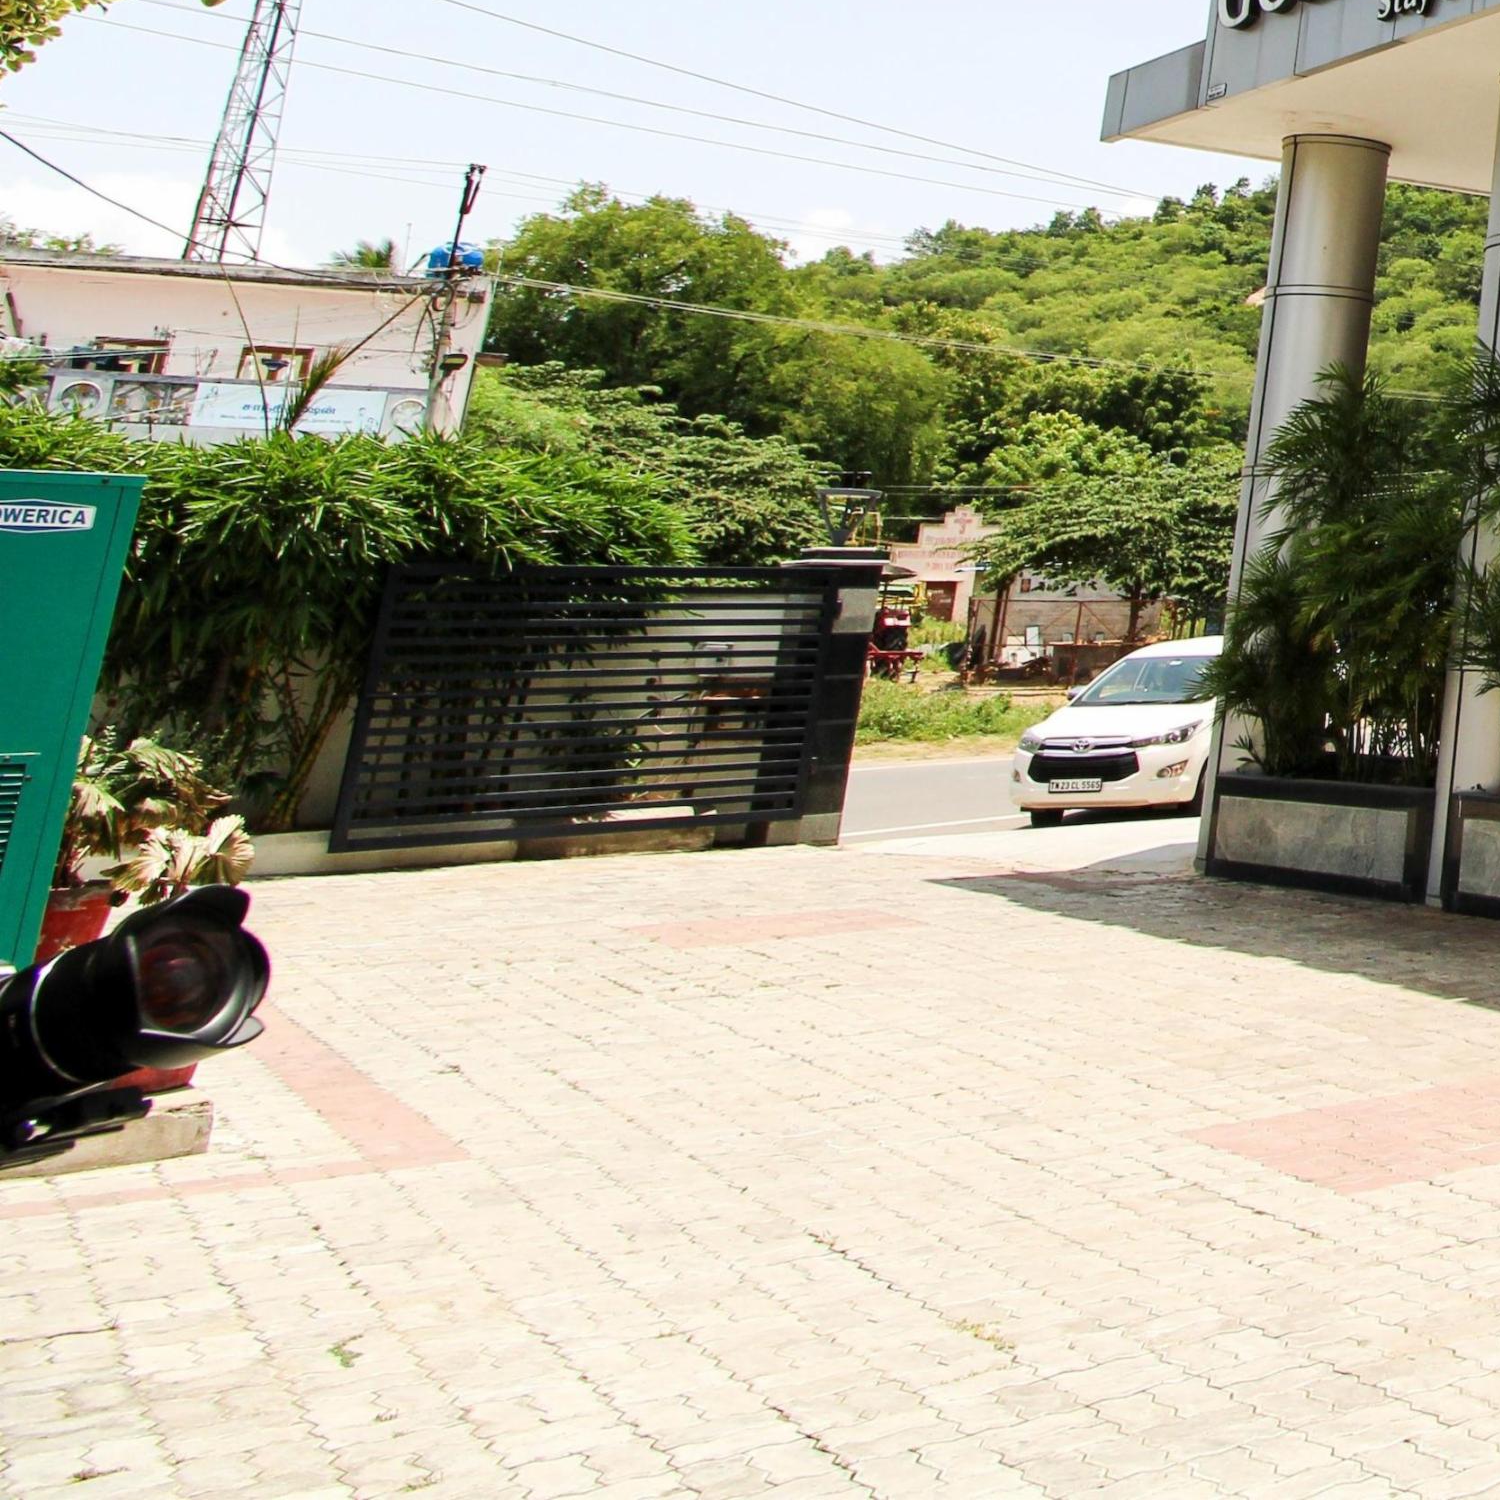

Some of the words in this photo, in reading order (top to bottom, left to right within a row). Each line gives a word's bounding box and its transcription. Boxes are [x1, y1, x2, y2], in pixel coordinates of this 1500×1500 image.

[0, 507, 87, 525] WERICA
[1051, 781, 1060, 790] TN
[1061, 781, 1070, 790] 23
[1071, 781, 1080, 789] CL
